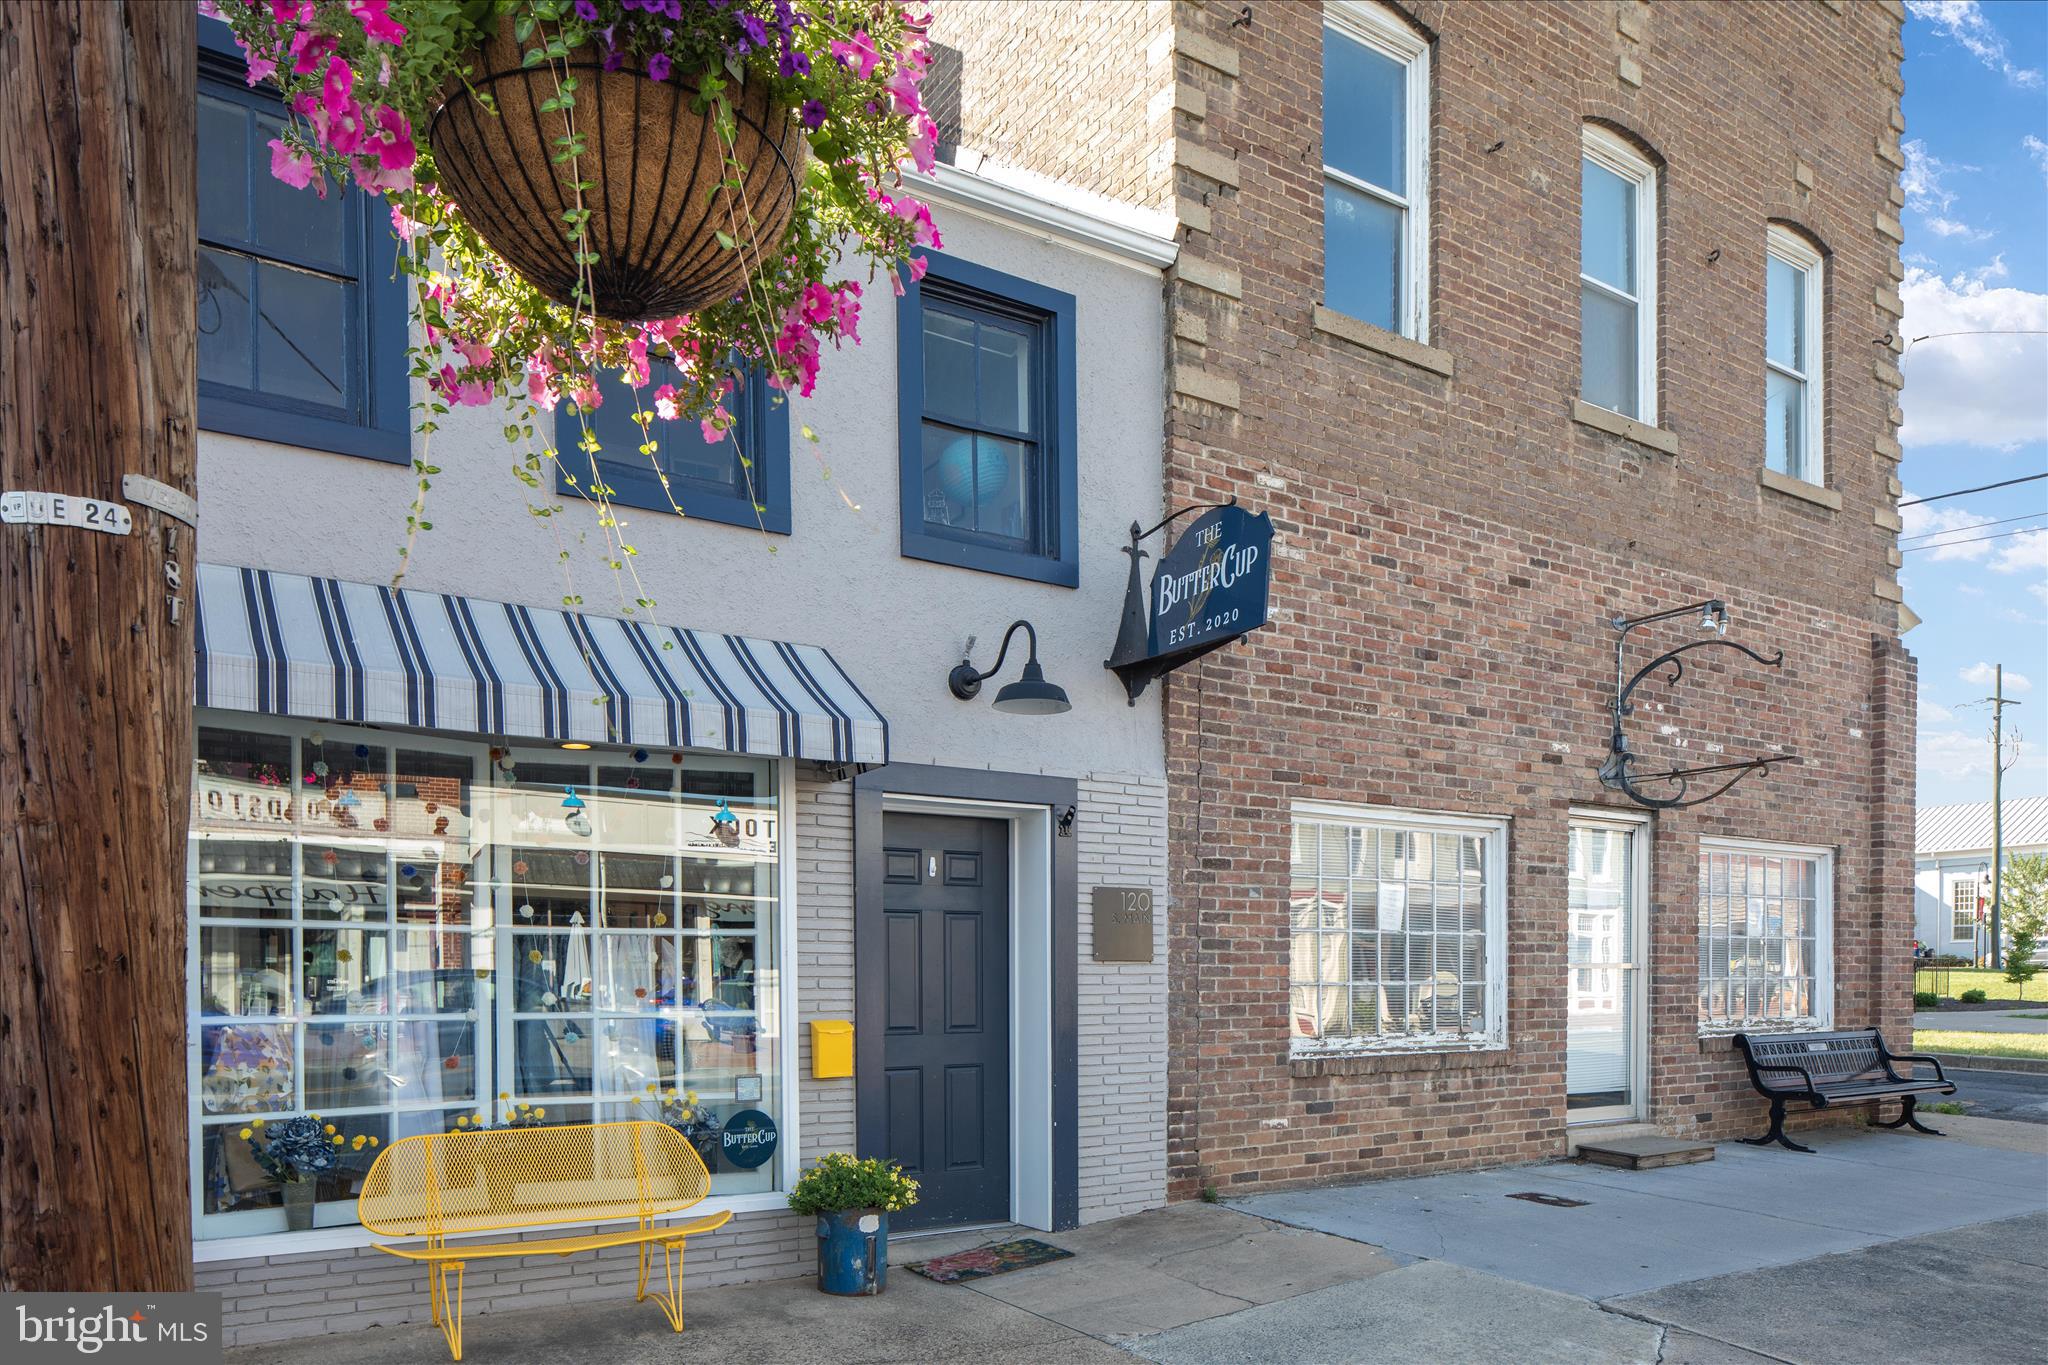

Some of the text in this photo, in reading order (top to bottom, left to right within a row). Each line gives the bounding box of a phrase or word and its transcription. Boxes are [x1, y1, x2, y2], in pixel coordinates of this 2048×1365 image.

[53, 499, 65, 519] E
[85, 503, 118, 527] 24
[1195, 521, 1222, 547] THE
[1169, 608, 1239, 646] EST. 2020
[1121, 892, 1150, 911] 120
